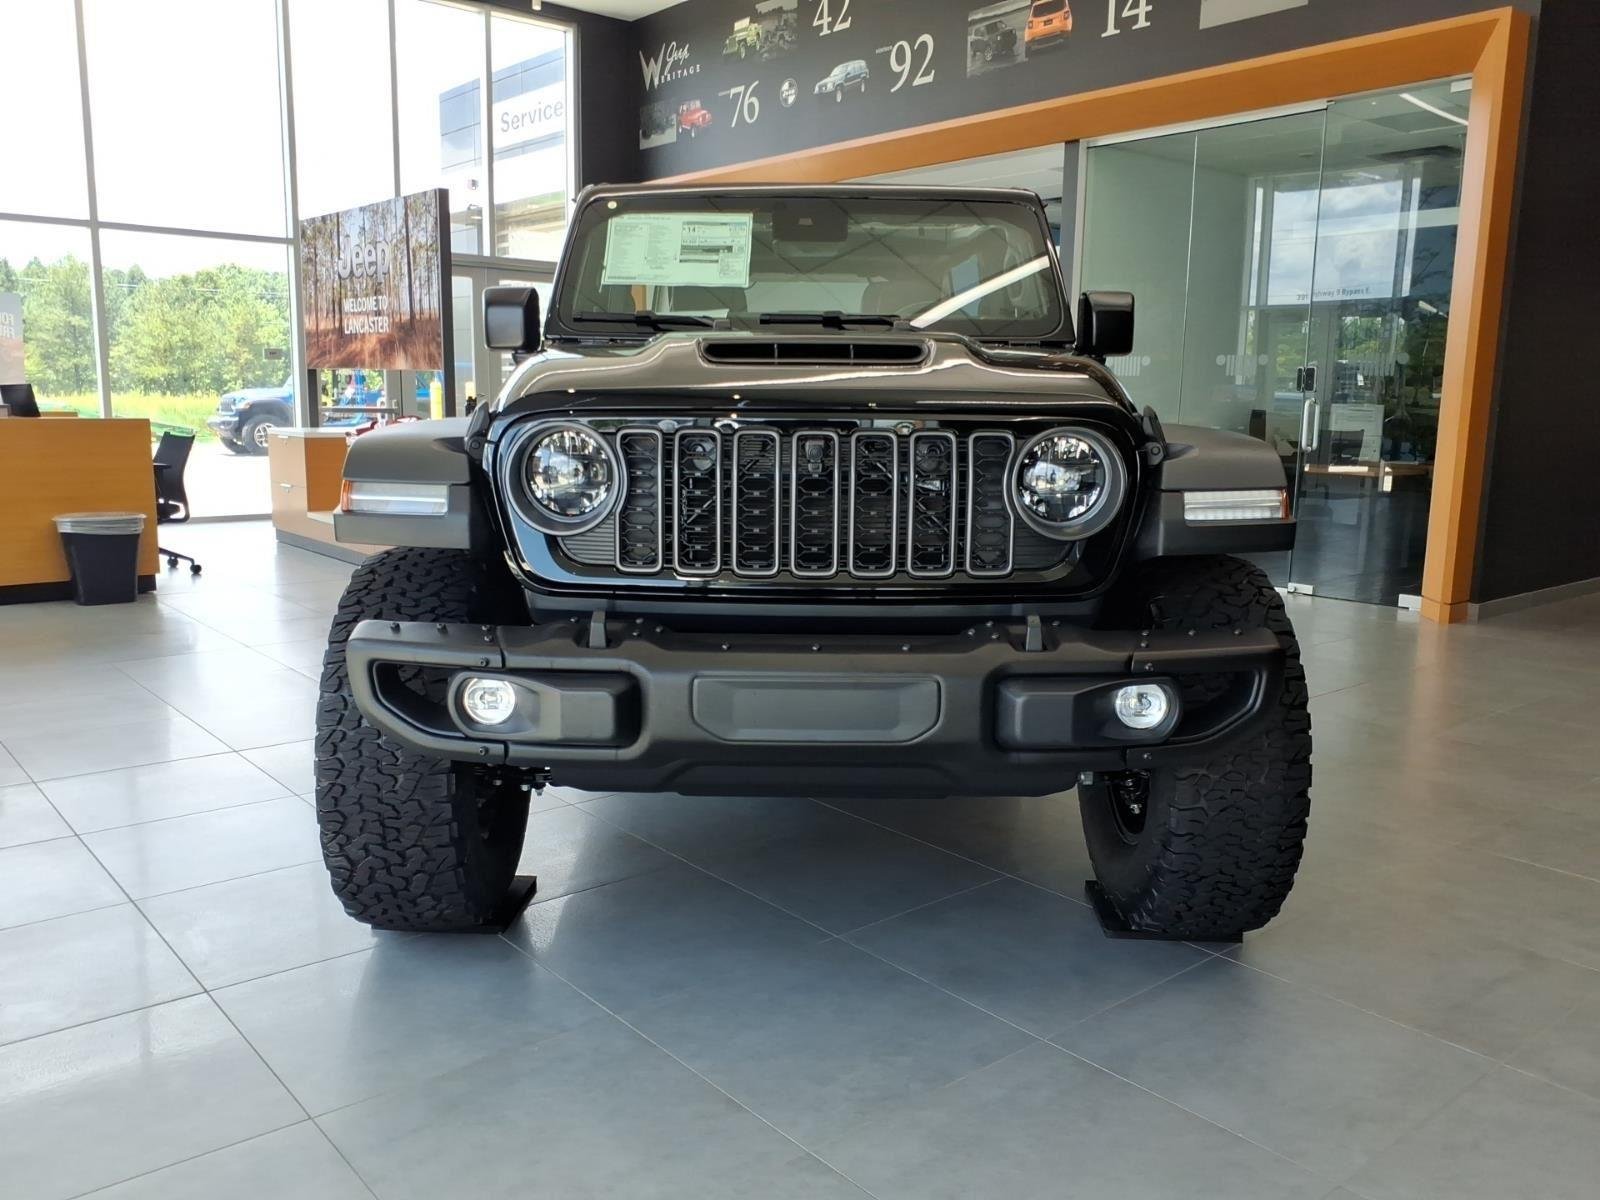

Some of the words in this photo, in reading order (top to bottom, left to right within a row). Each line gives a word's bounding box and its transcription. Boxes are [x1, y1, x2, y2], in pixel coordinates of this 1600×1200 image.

[812, 0, 852, 36] 42
[1101, 0, 1152, 38] 14
[889, 33, 935, 93] 92
[500, 100, 564, 133] Service
[730, 80, 760, 128] 76
[337, 234, 391, 285] Jeep
[344, 295, 378, 313] WELCOME
[377, 295, 388, 311] TO
[344, 316, 390, 335] LANCASTER
